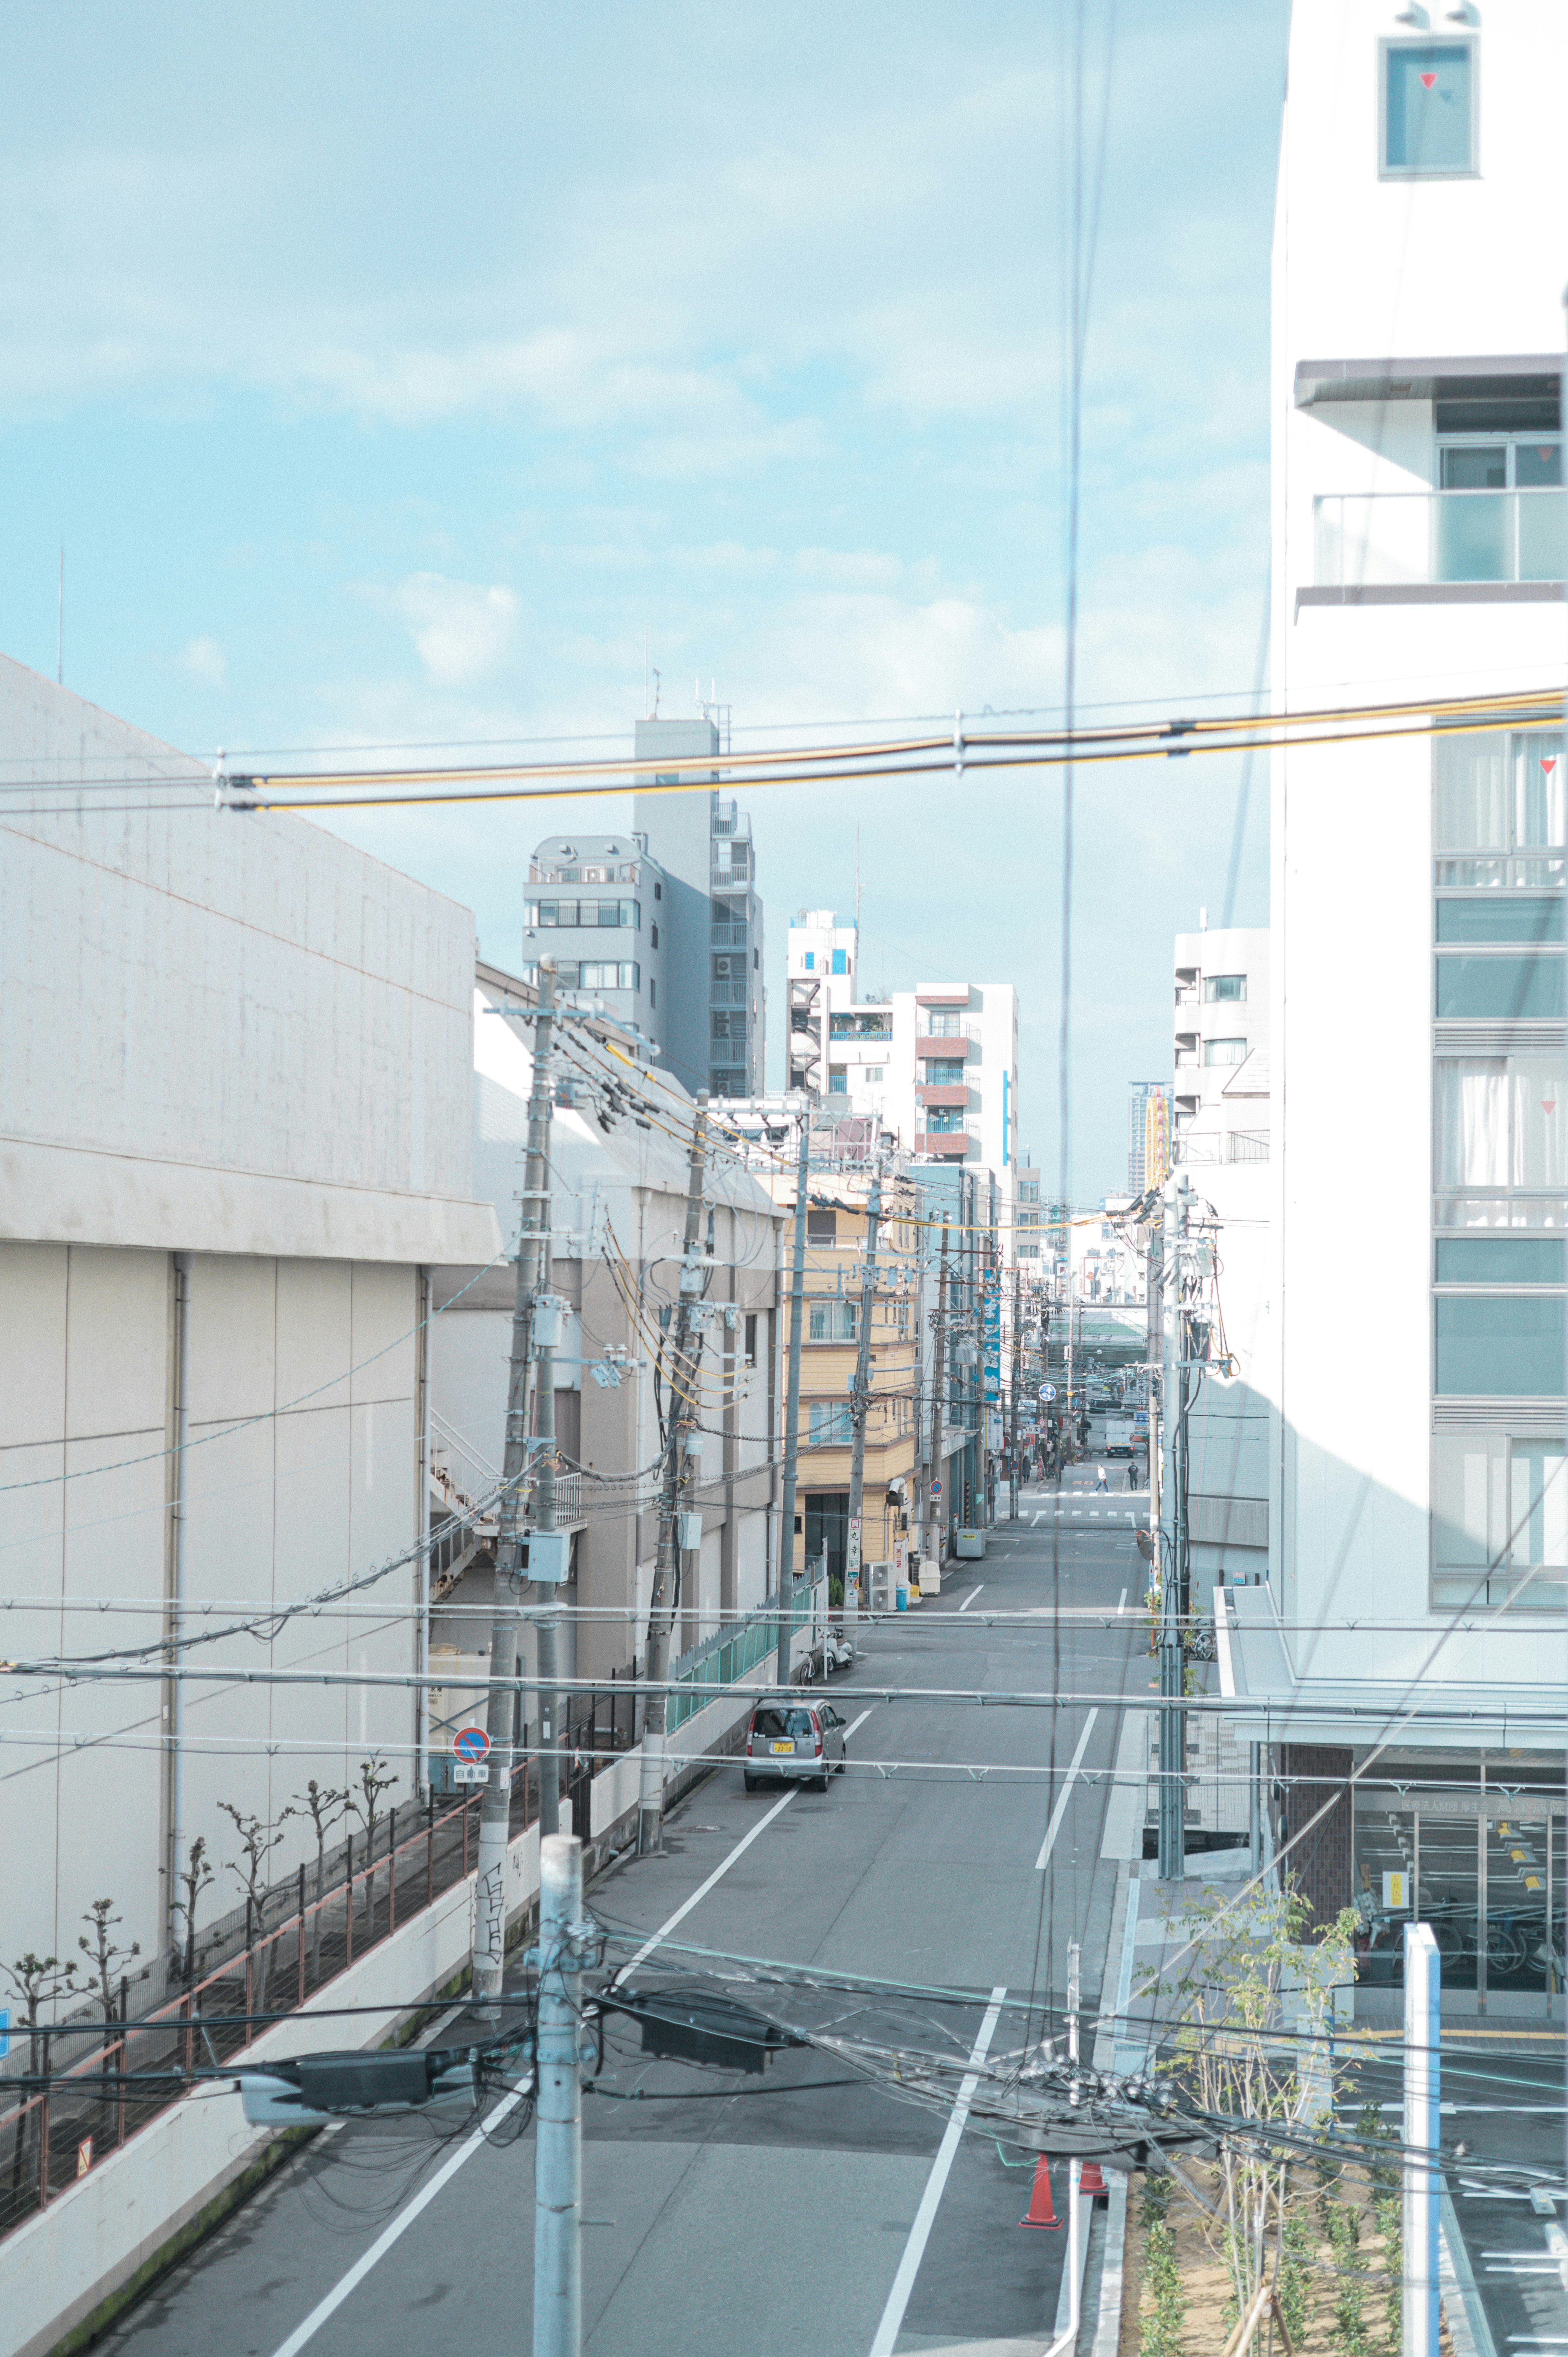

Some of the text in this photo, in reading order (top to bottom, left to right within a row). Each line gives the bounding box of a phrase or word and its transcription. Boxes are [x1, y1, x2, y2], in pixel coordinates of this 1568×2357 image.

[850, 1531, 859, 1556] 丸幸
[456, 1770, 486, 1779] 自動車
[1402, 1800, 1458, 1811] 医療法人財団
